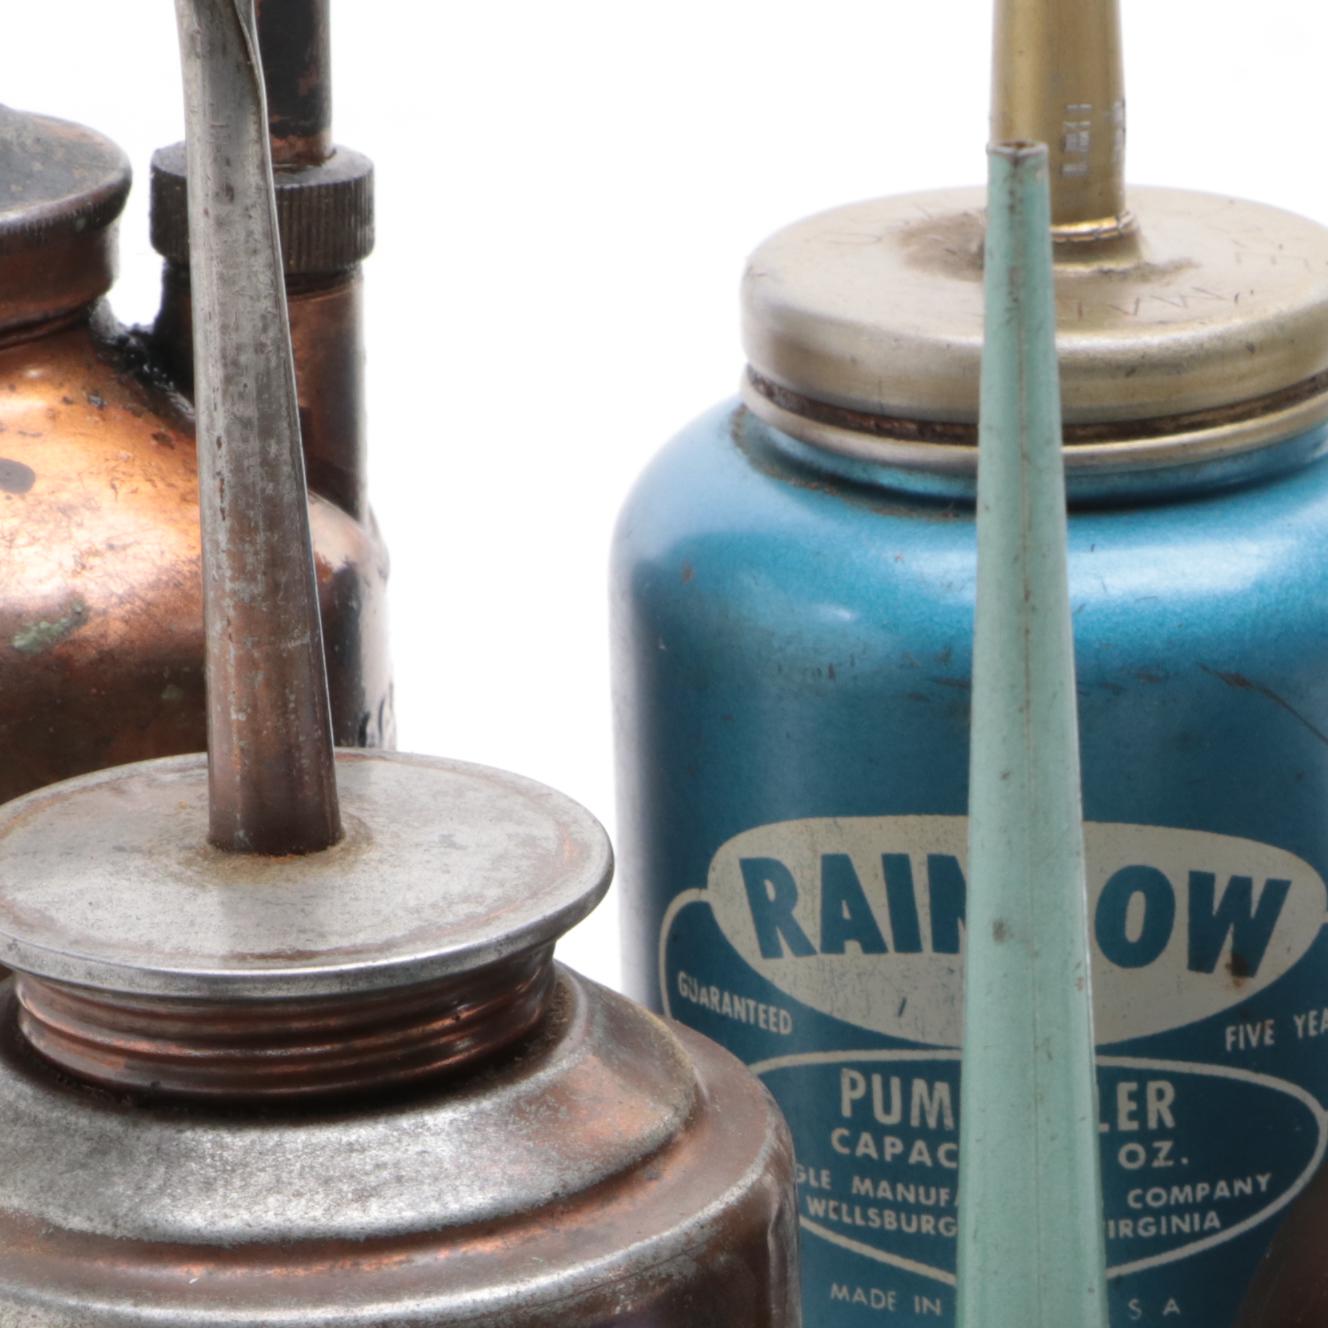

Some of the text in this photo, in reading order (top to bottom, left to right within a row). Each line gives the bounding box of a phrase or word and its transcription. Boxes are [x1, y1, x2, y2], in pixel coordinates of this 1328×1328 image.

[739, 852, 1292, 978] RAINOW
[677, 970, 793, 1036] GUARANTEED
[1224, 1018, 1276, 1052] FIVE
[839, 1066, 957, 1131] PUM
[830, 1126, 1190, 1170] CAPAC OZ.
[1126, 1172, 1273, 1209] COMPANY
[804, 1194, 1222, 1240] WELLSBURG IRGINIA
[831, 1281, 897, 1313] MADE
[913, 1294, 944, 1317] IN
